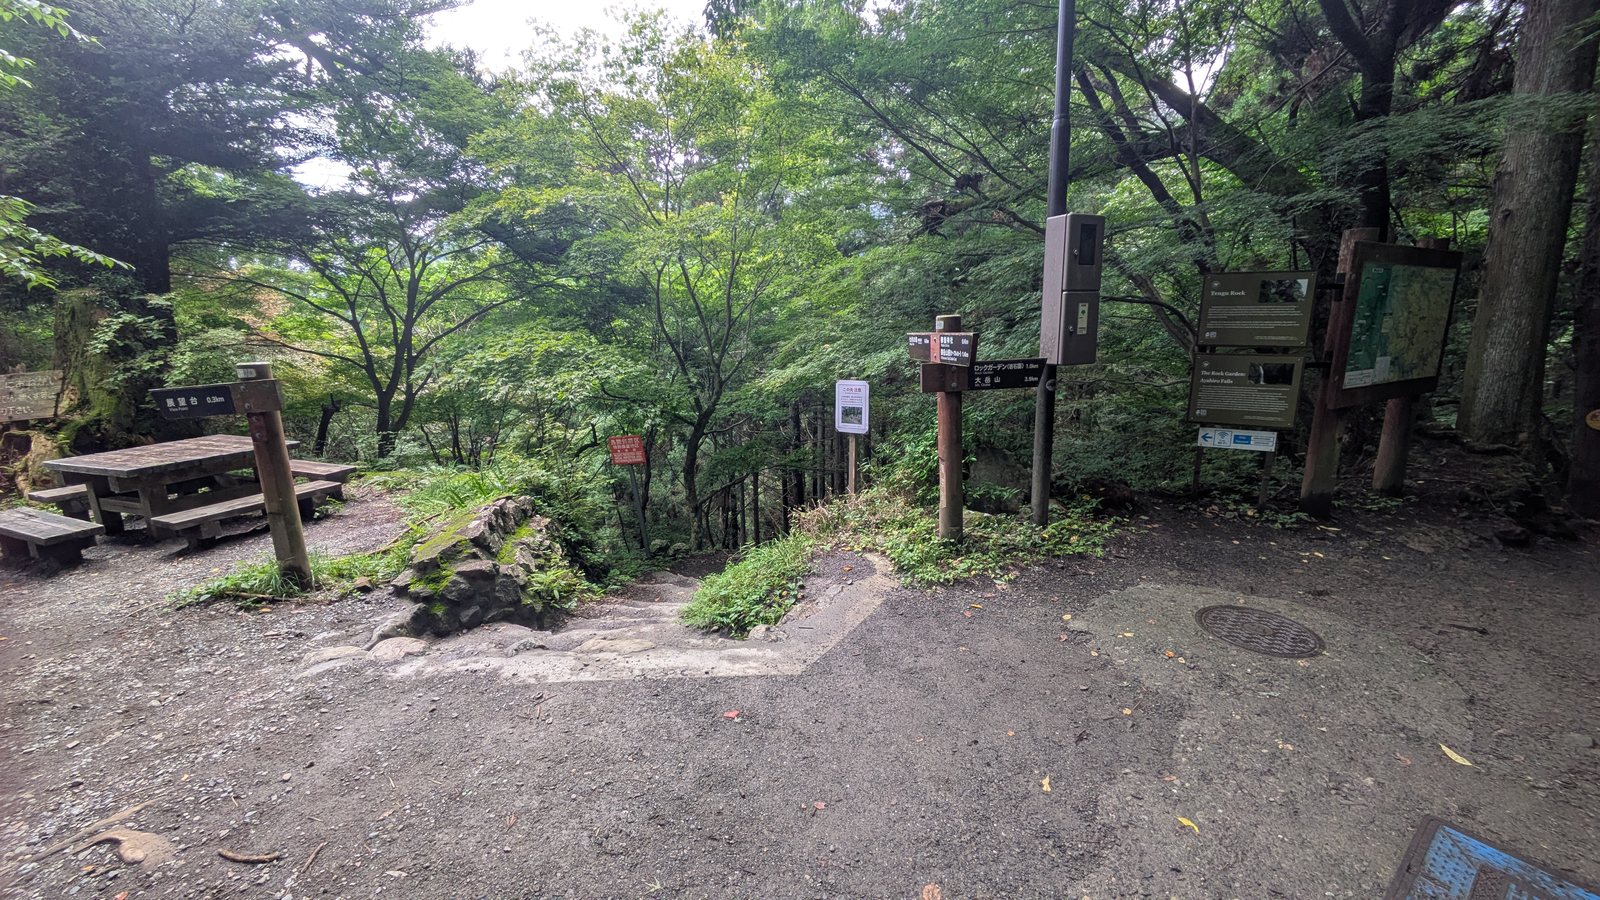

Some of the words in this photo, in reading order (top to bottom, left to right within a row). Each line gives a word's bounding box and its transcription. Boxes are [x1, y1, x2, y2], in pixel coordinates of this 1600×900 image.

[974, 376, 1001, 384] 大岳山
[166, 396, 198, 407] 展望台
